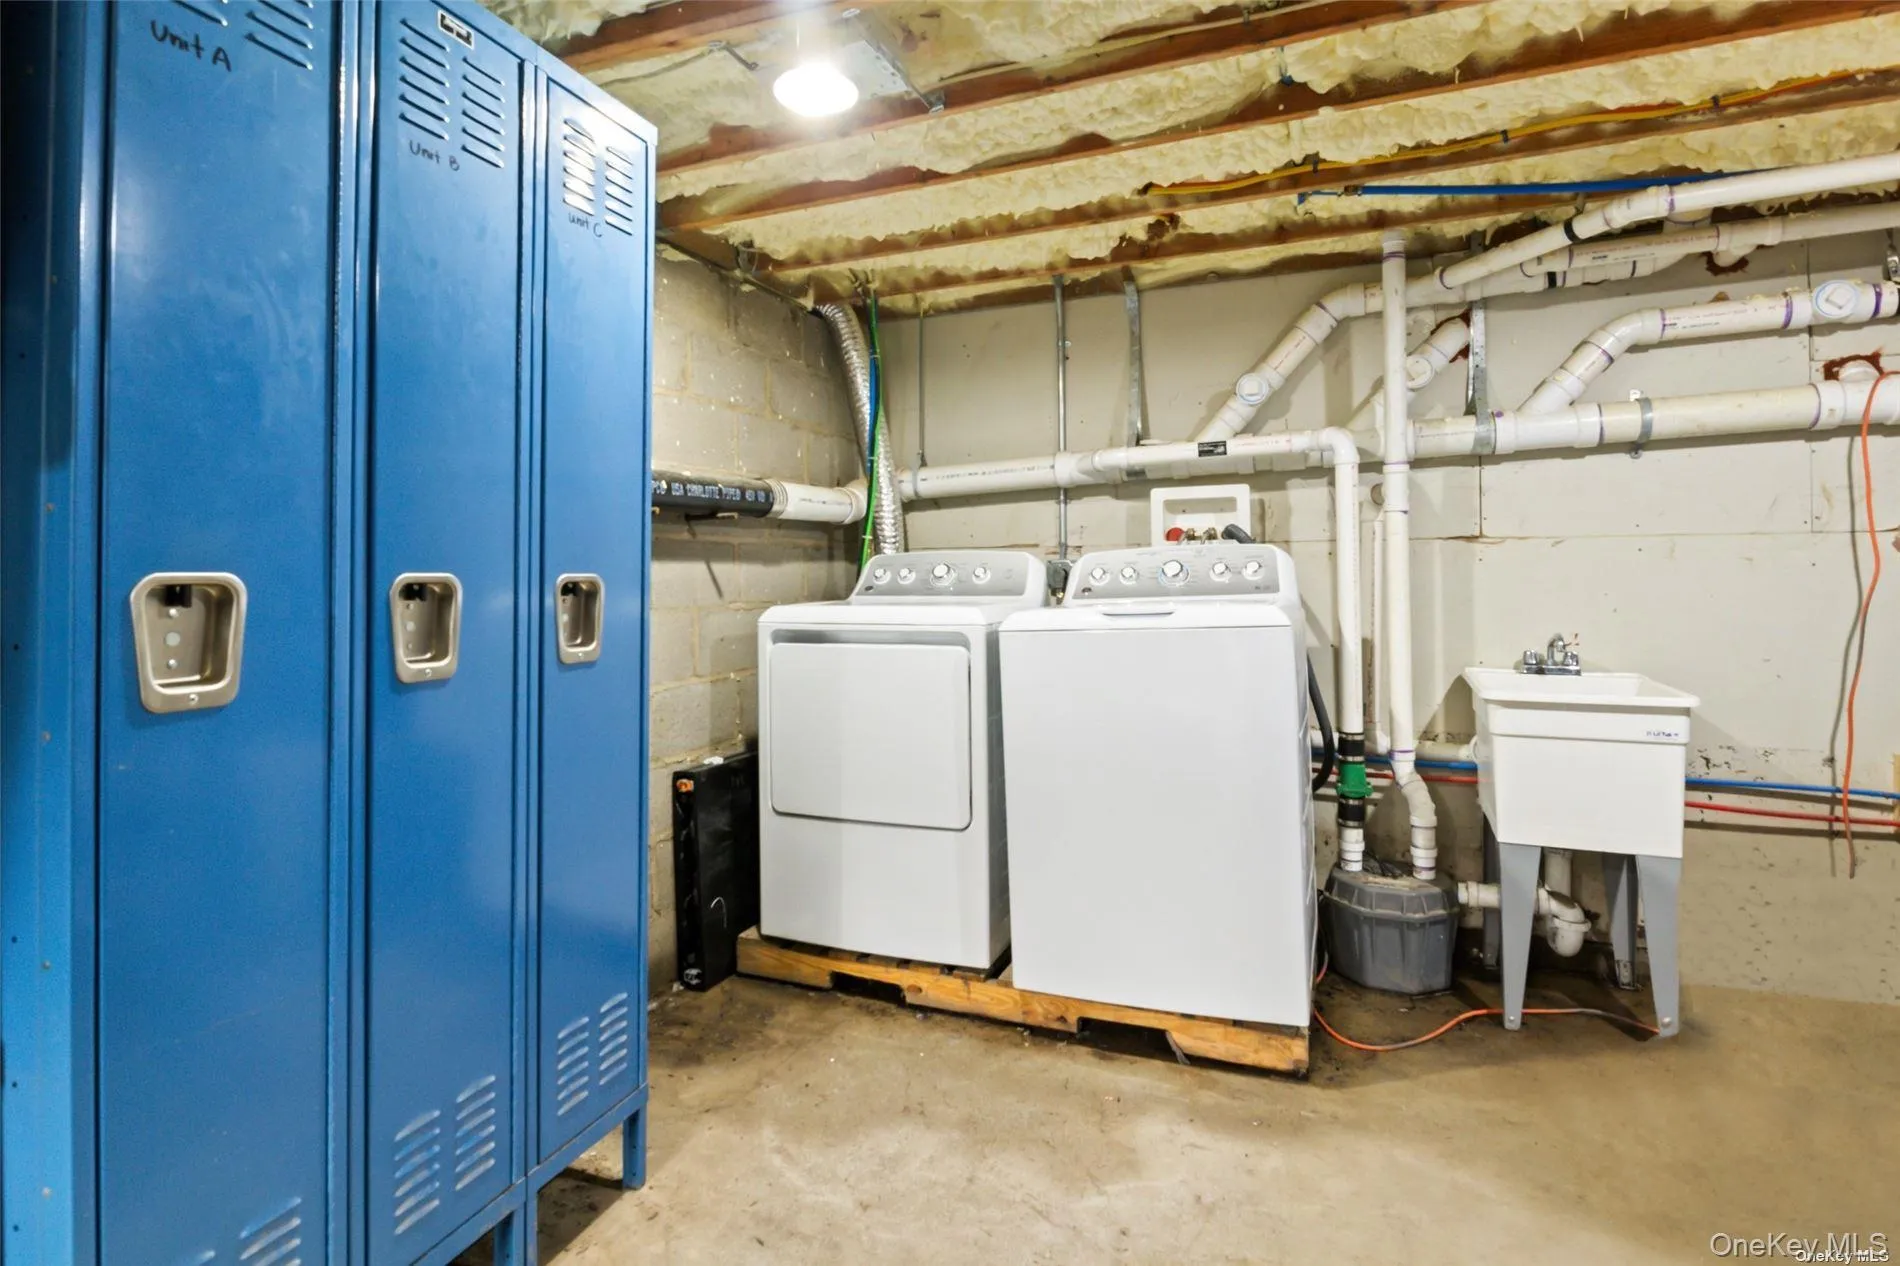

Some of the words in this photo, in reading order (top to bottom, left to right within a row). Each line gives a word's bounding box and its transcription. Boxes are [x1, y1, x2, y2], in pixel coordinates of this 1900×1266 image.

[151, 20, 205, 59] Unit
[212, 46, 232, 72] A
[409, 140, 440, 165] Unit
[448, 155, 460, 172] B
[593, 222, 603, 238] C
[671, 482, 684, 496] USA
